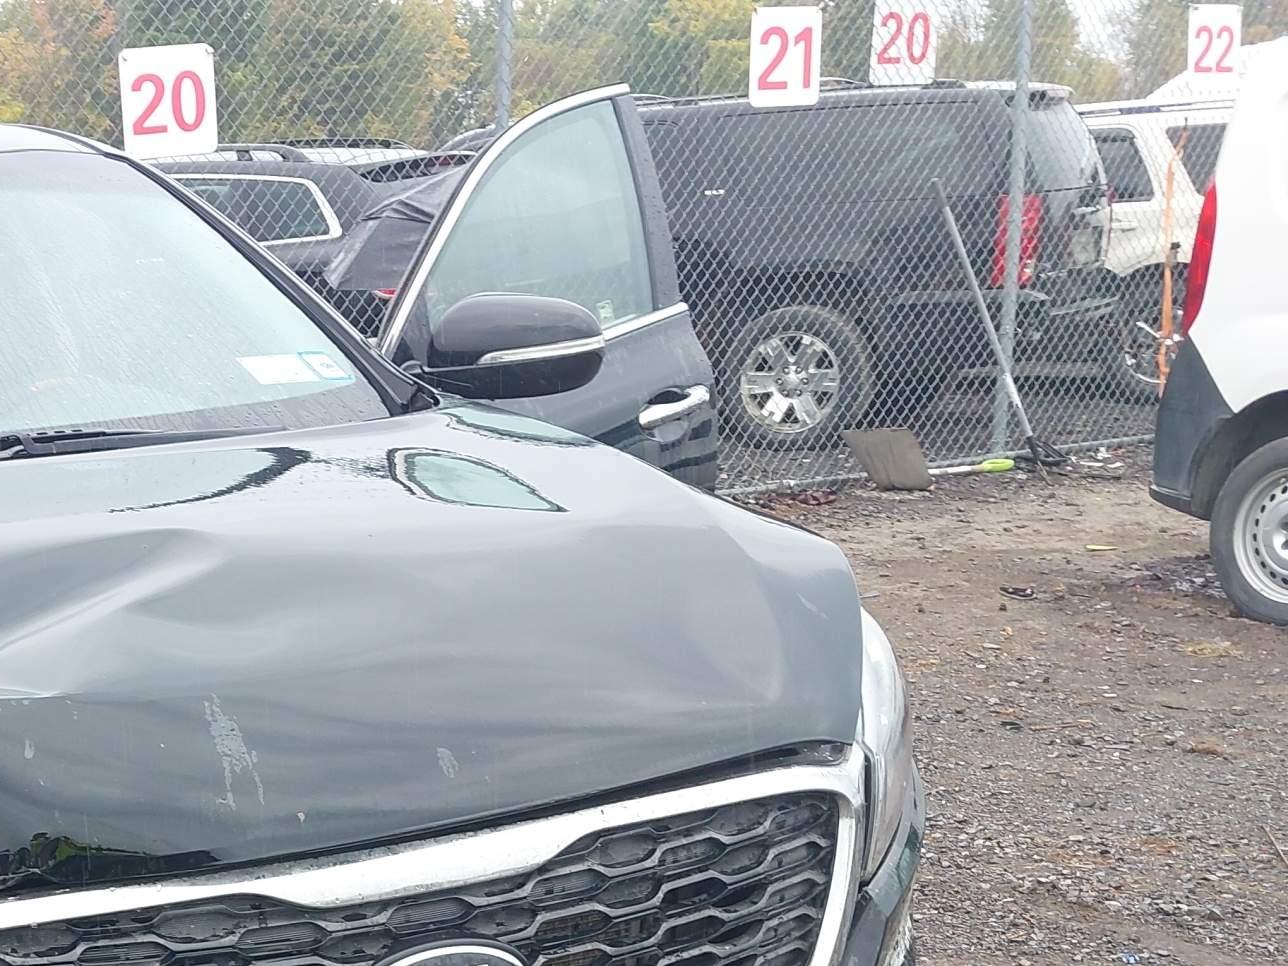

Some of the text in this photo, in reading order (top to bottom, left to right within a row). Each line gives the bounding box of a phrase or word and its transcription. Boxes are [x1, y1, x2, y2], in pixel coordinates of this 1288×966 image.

[757, 26, 813, 91] 21
[876, 11, 931, 65] 20
[1194, 25, 1234, 73] 22
[131, 70, 206, 136] 20
